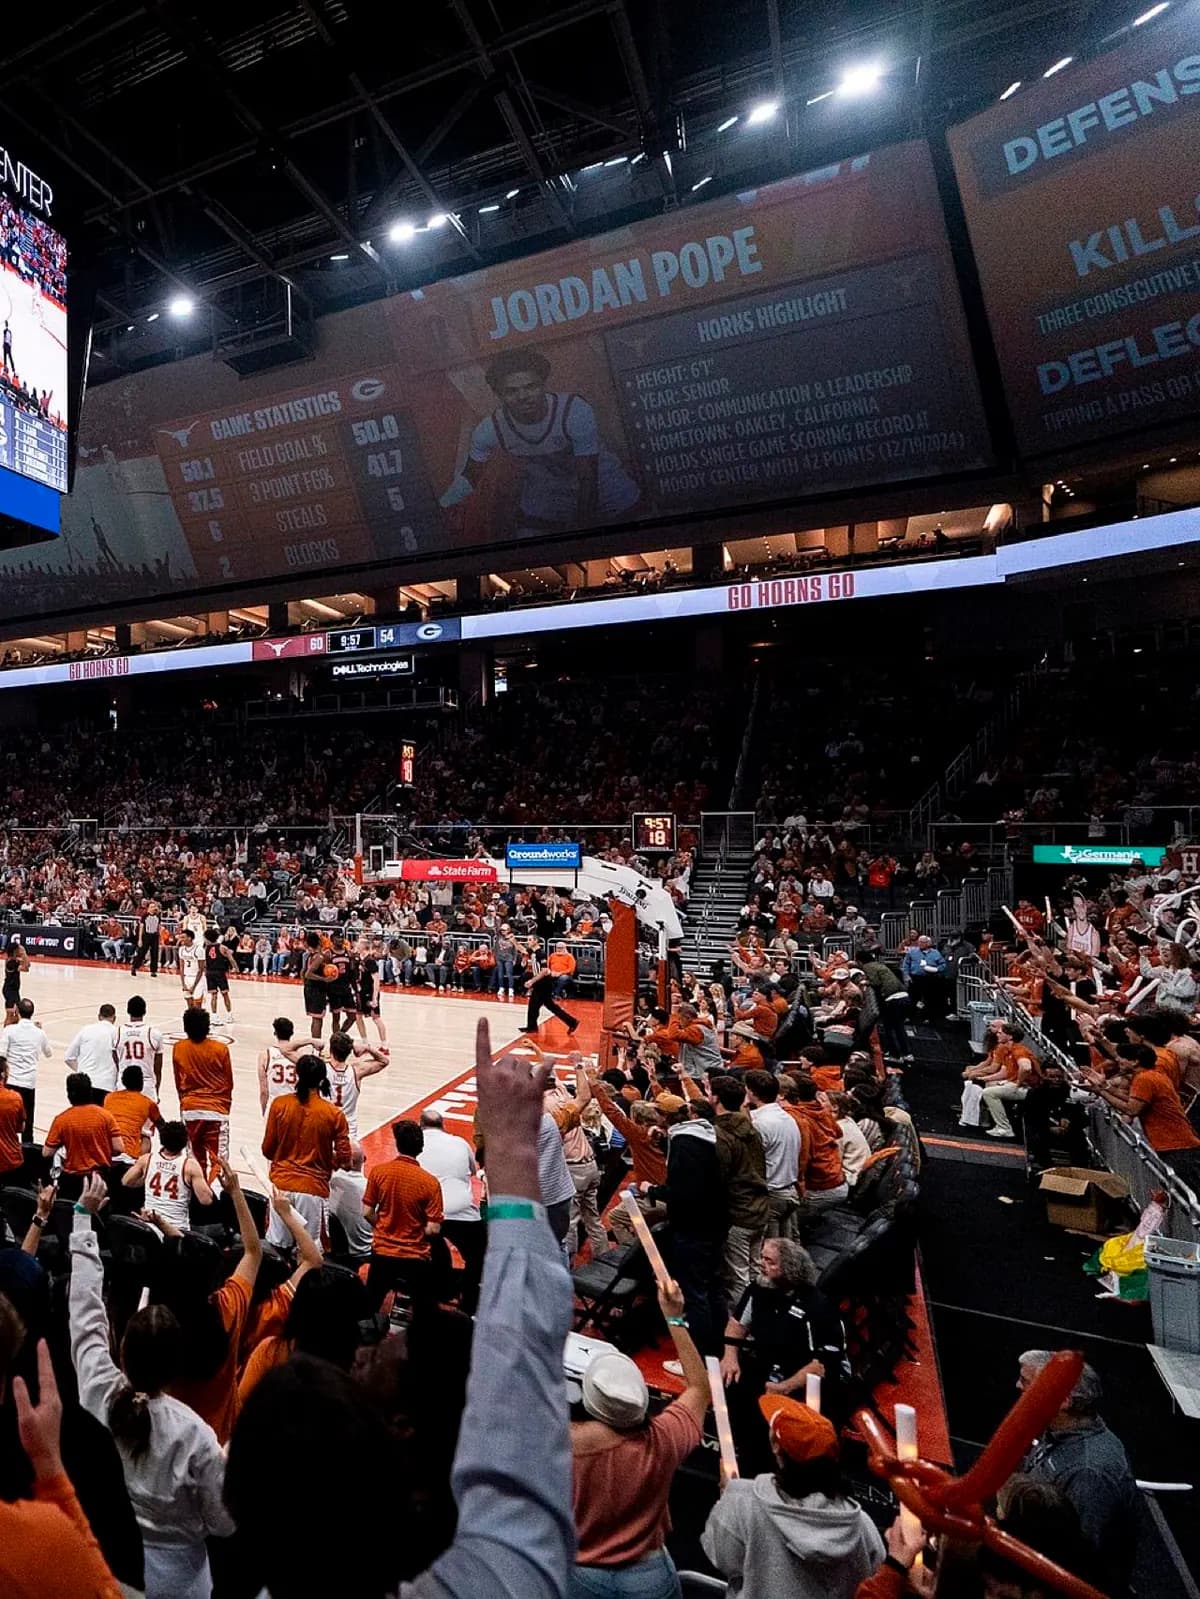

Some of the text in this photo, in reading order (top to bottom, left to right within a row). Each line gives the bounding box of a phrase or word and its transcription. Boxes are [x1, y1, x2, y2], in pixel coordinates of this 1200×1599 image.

[1068, 195, 1200, 277] KILL
[489, 226, 763, 340] JORDAN POPE
[1038, 262, 1195, 334] THREE CONSECUTIVE
[697, 288, 848, 343] HORNS HIGHLIGHT
[636, 365, 688, 389] HEIGHT:
[640, 377, 730, 411] YEAR: SENIOR
[645, 407, 696, 434] MAJOR:
[698, 382, 810, 423] COMMUNICATION
[828, 365, 913, 397] LEADERSHIP
[1119, 381, 1166, 409] PASS
[210, 392, 343, 441] GAME STATISTICS
[351, 414, 400, 446] 50.0
[650, 423, 732, 454] HOMETOWN:
[794, 396, 880, 428] CALIFORNIA
[238, 447, 274, 472] FIELD
[274, 438, 313, 466] GOAL
[313, 435, 328, 457] %
[655, 450, 699, 476] HOLDS
[700, 445, 746, 468] SINGLE
[748, 437, 789, 459] GAME
[790, 425, 854, 453] SCORING
[855, 415, 911, 444] RECORD
[368, 449, 403, 478] 41.7
[658, 468, 707, 494] MOODY
[709, 460, 761, 487] CENTER
[761, 454, 800, 478] WITH
[820, 443, 876, 469] POINTS
[249, 481, 261, 503] 3
[261, 472, 304, 501] POINT
[304, 467, 336, 492] FG%
[386, 486, 405, 511] 5
[275, 503, 328, 532] STEALS
[284, 538, 340, 566] BLOCKS
[728, 573, 855, 610] GO HORNS GO
[310, 638, 324, 651] 60
[340, 633, 361, 647] 9:57
[379, 628, 394, 644] 54
[69, 657, 129, 680] GO HORNS GO
[357, 660, 408, 674] Technologies
[644, 817, 671, 830] 9:57
[649, 831, 666, 846] 18
[508, 849, 578, 860] Groundworks
[442, 865, 491, 876] State Farm
[63, 936, 75, 951] G
[124, 1041, 144, 1060] 10
[272, 1064, 297, 1084] 33
[334, 1086, 343, 1107] 1
[149, 1172, 179, 1200] 44
